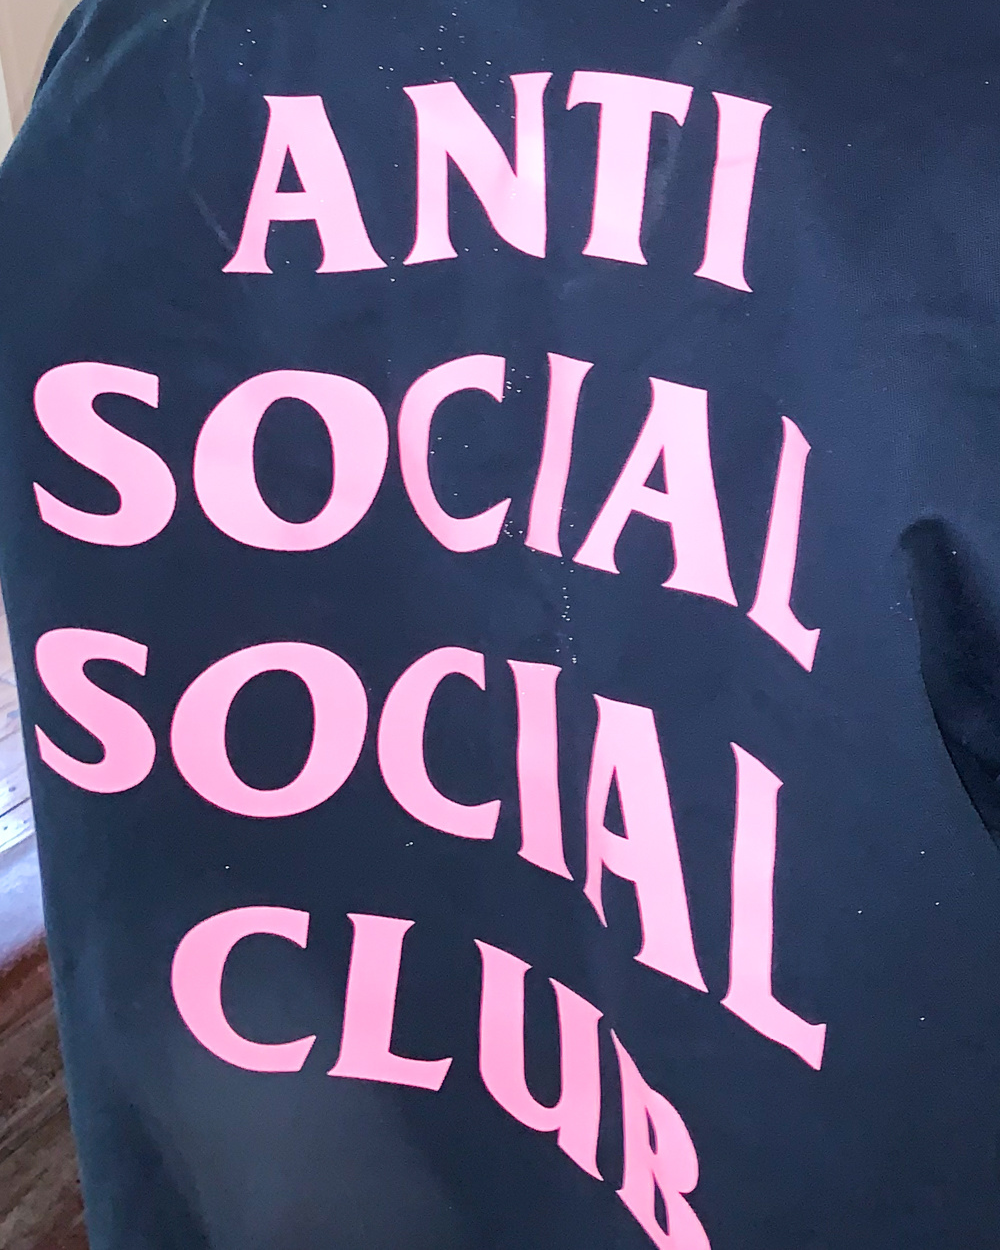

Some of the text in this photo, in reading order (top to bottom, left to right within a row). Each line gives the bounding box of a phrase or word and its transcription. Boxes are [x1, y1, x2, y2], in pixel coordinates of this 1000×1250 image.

[222, 70, 773, 293] ANTI
[32, 352, 822, 672] SOCIAL
[33, 627, 827, 1070] SOCIAL
[171, 905, 712, 1250] CLUB
